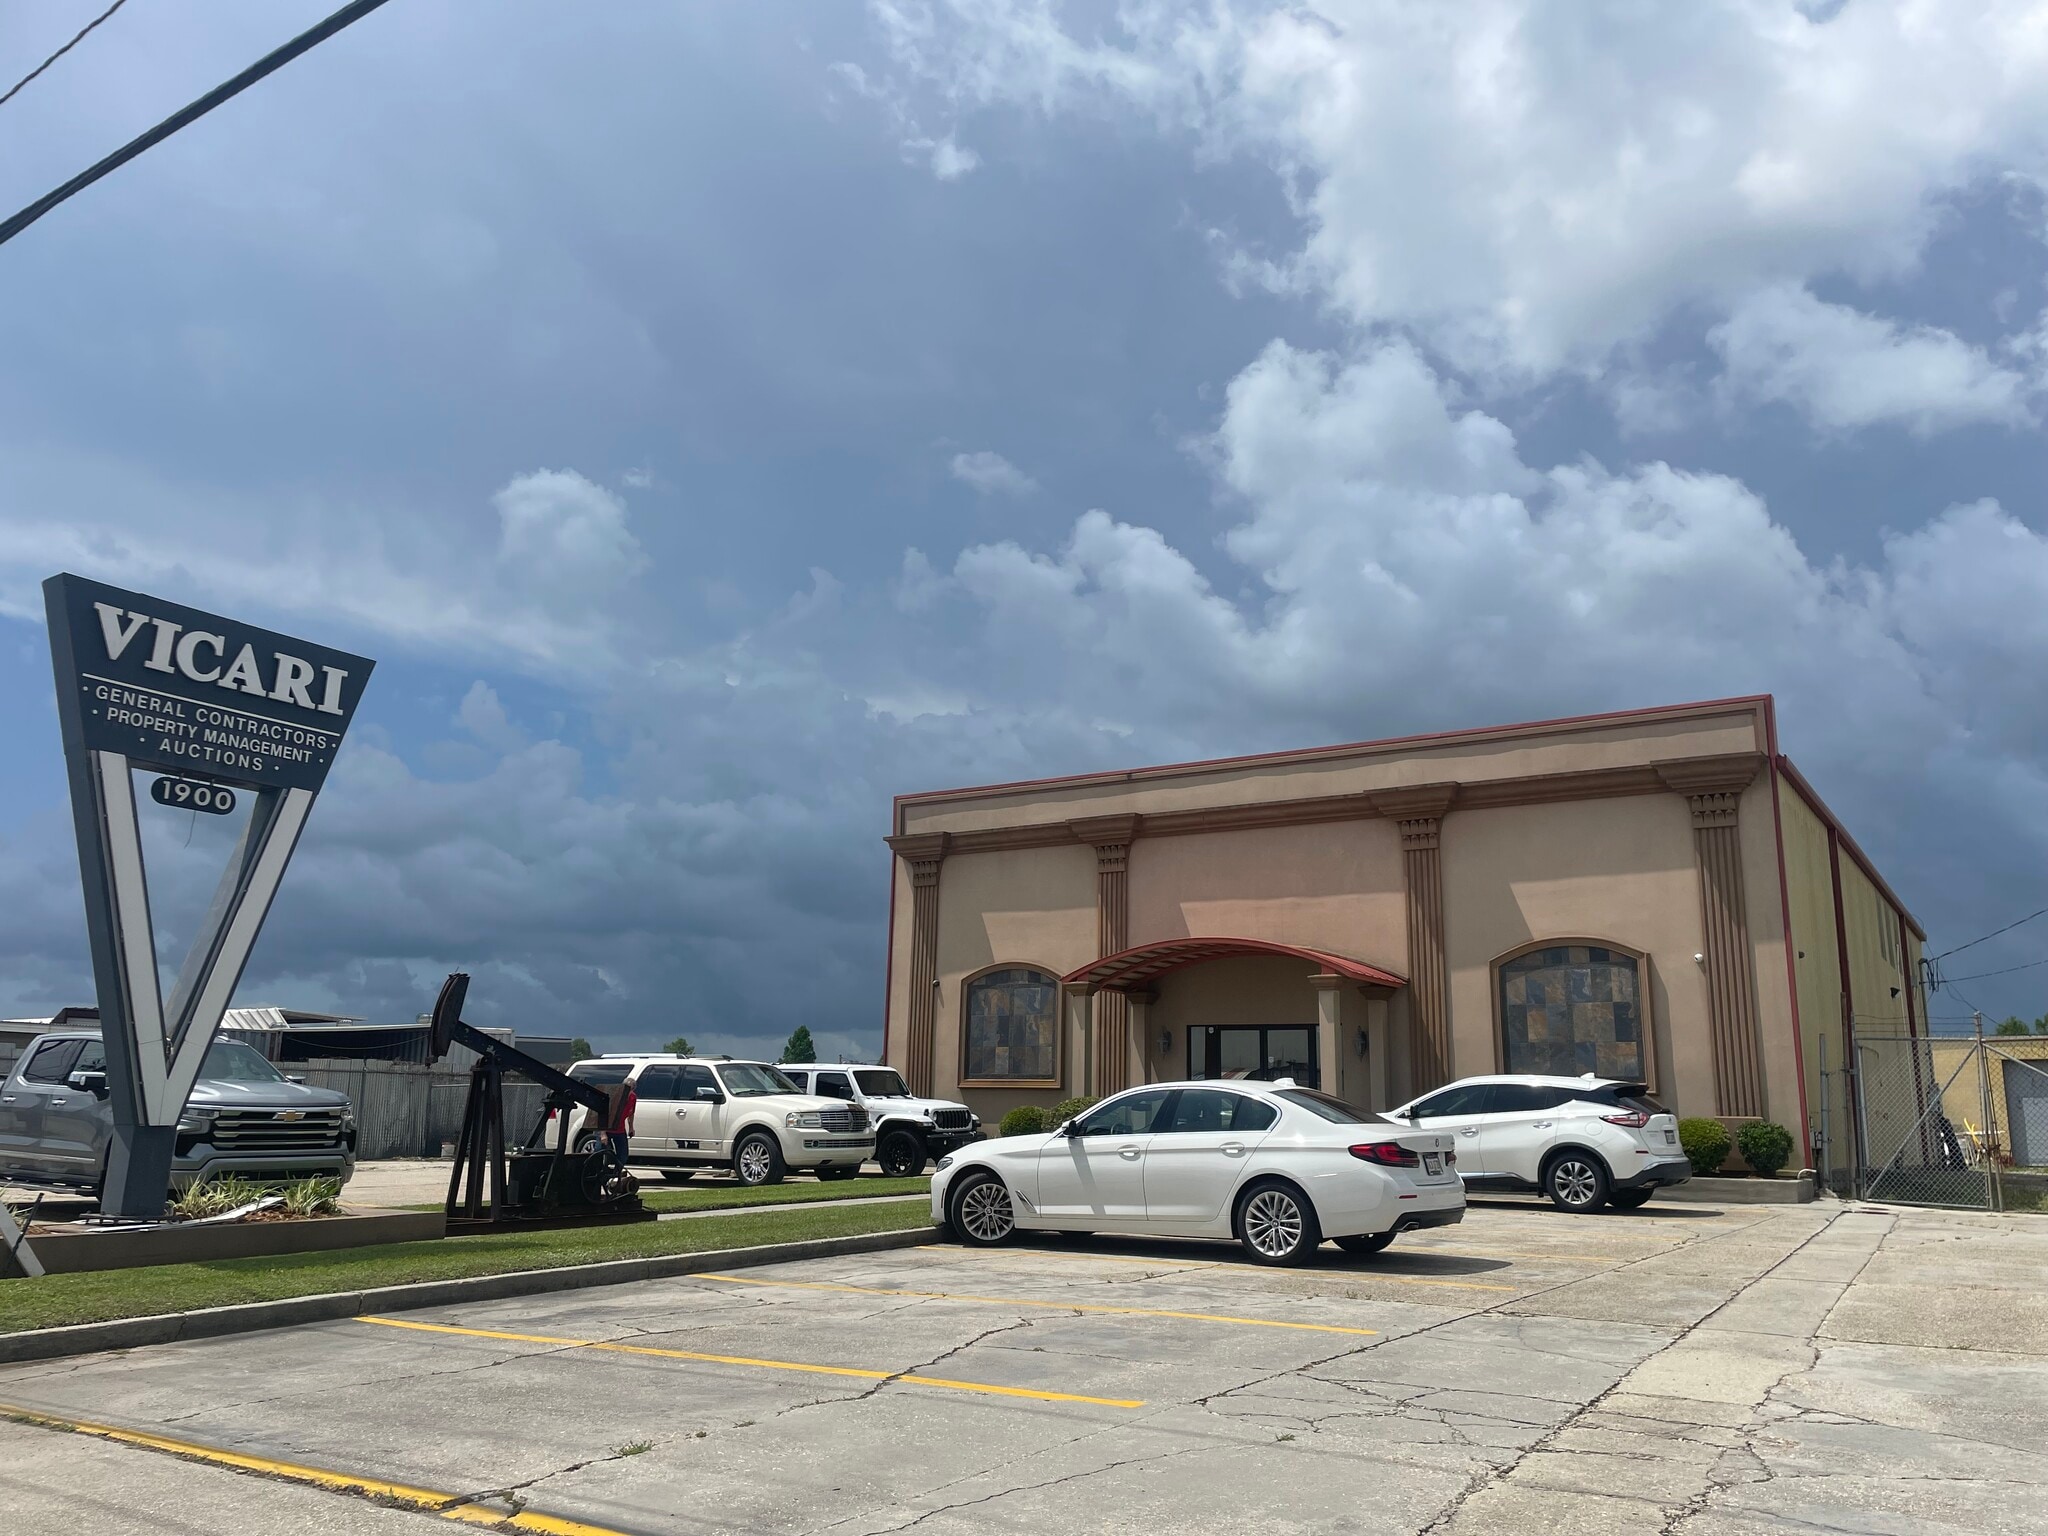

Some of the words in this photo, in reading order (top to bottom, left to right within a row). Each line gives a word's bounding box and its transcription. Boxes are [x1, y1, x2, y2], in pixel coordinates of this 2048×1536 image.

[93, 602, 348, 716] VICARI
[95, 685, 186, 718] GENERAL
[195, 708, 327, 749] CONTRACTORS
[106, 707, 198, 739] PROPERTY
[204, 728, 313, 764] MANAGEMENT
[159, 738, 263, 771] AUCTIONS
[162, 780, 232, 810] 1900
